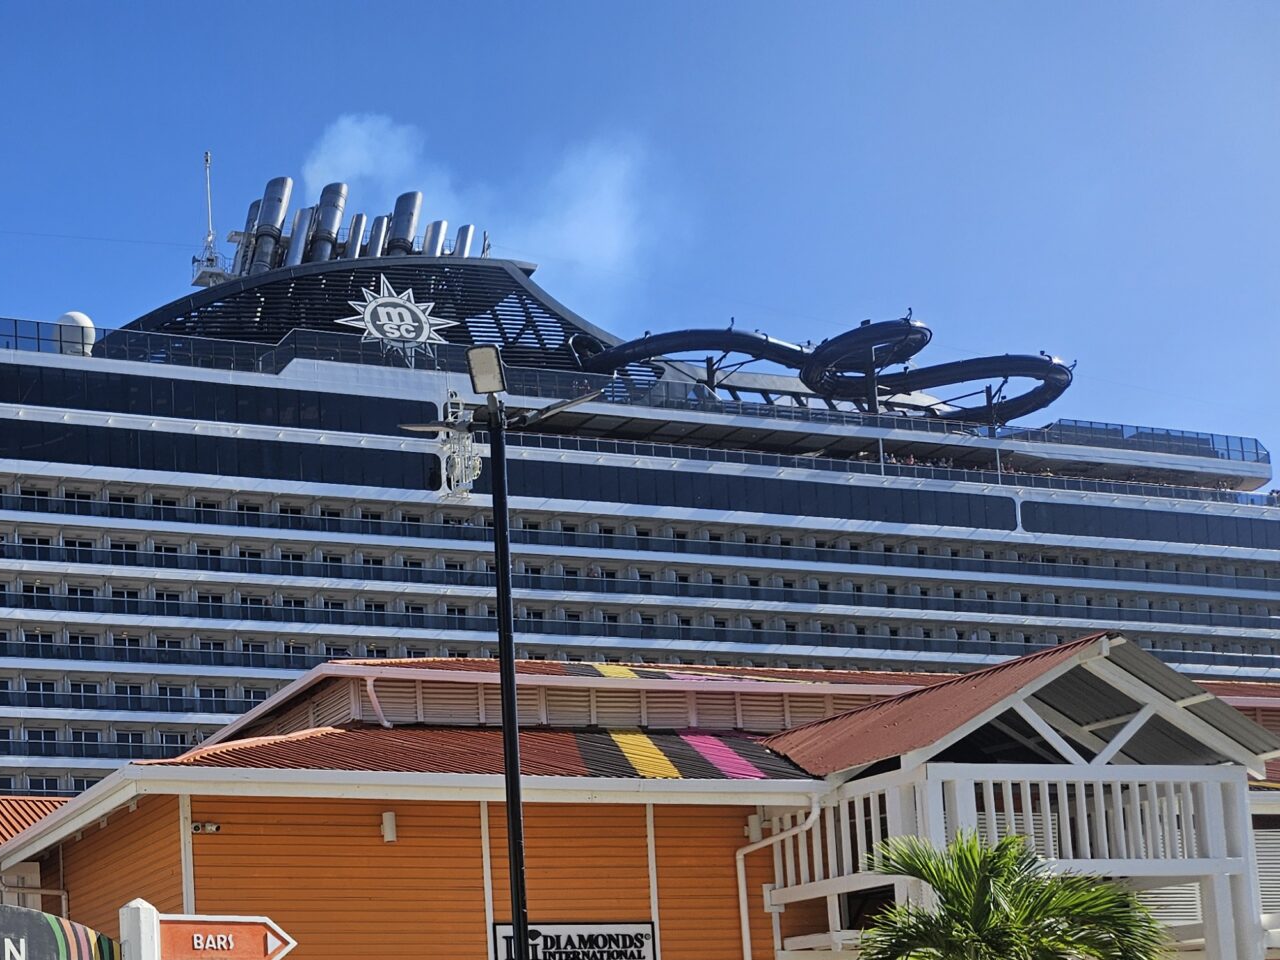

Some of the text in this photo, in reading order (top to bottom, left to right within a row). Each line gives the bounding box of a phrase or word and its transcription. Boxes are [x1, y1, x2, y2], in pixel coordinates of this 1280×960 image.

[193, 934, 234, 950] BARS
[542, 933, 645, 950] DIAMONDS
[543, 950, 645, 960] INTERNATIONAL
